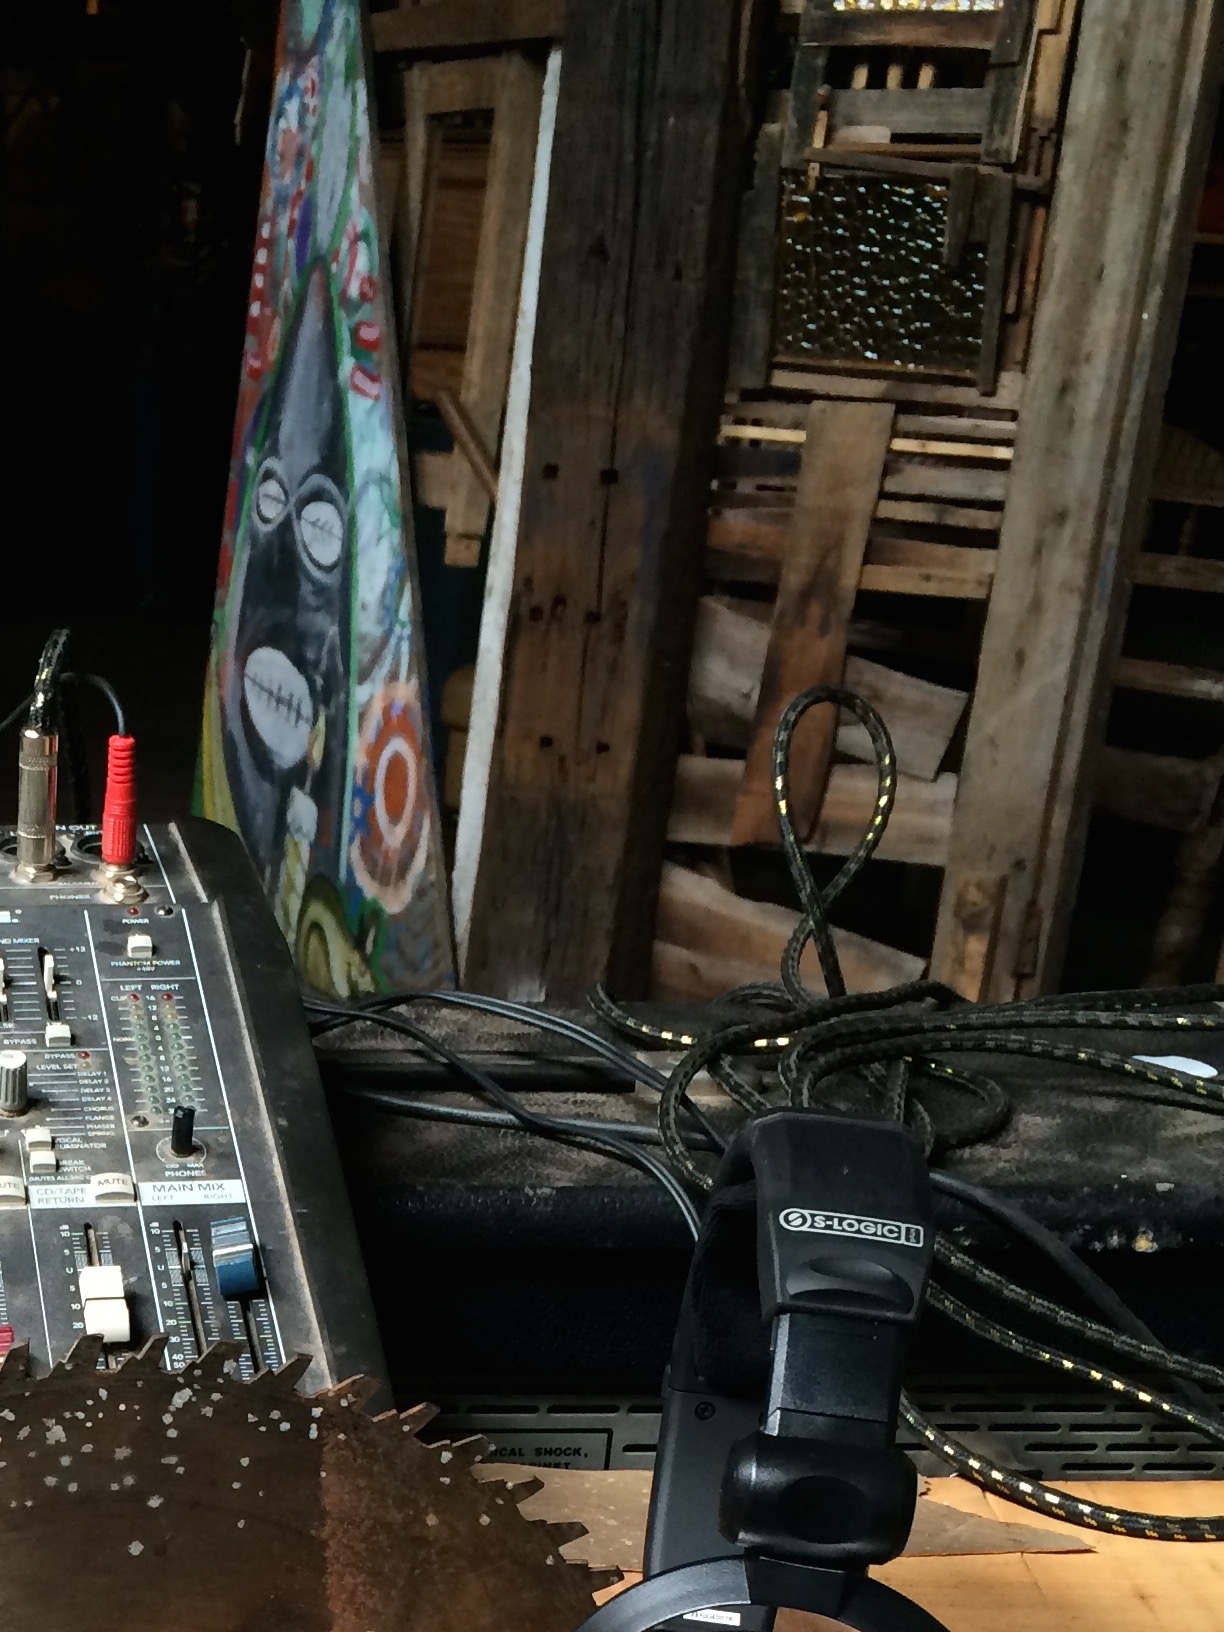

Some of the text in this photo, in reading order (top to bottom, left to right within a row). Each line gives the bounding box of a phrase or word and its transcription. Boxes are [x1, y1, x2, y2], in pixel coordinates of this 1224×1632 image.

[97, 1178, 128, 1186] MUTE
[37, 1187, 87, 1195] CD/TAPE
[152, 1183, 225, 1192] MAIN MIX
[814, 1215, 899, 1238] S-LOGIC
[535, 1448, 588, 1458] SHOCK,
